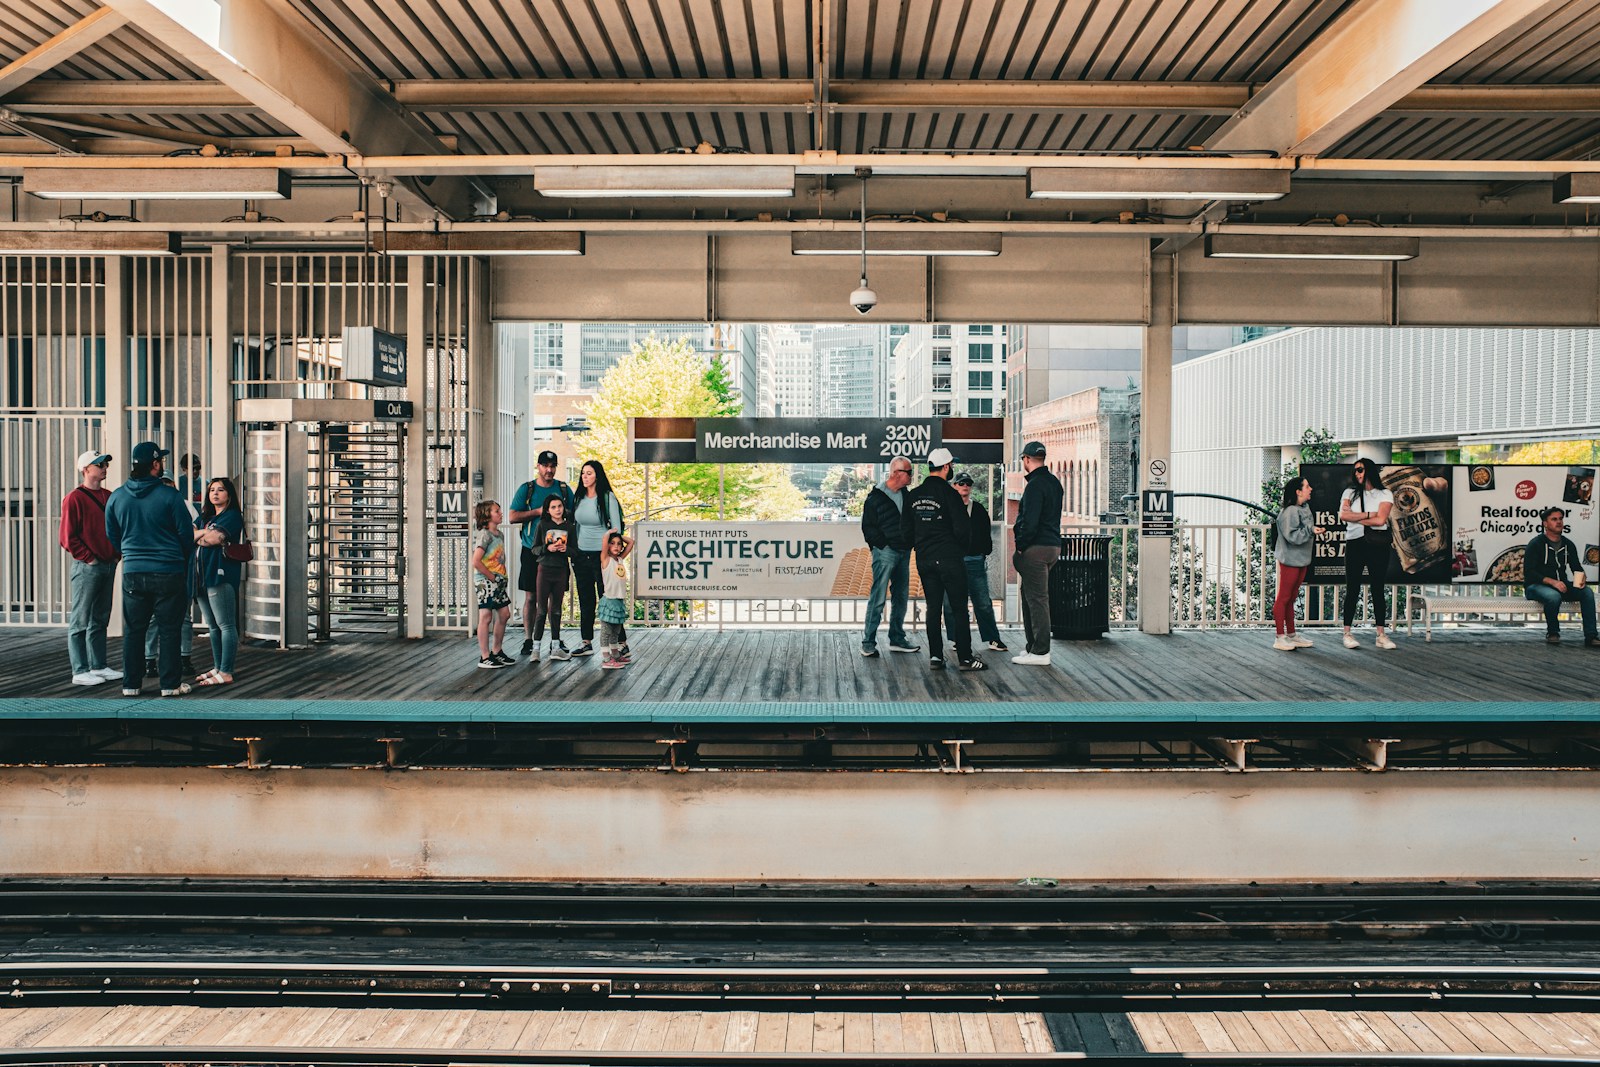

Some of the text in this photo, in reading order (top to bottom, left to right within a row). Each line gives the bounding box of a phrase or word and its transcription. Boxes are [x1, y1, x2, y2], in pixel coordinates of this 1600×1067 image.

[388, 403, 402, 415] Out
[704, 432, 868, 449] Merchandise Mart
[885, 425, 931, 441] 320N
[880, 441, 931, 456] 200W
[442, 493, 462, 512] M
[1148, 492, 1168, 511] M
[1316, 512, 1336, 526] It's
[1397, 507, 1432, 530] FLOYDS
[1482, 506, 1512, 518] Real
[1316, 530, 1346, 542] Nor
[1400, 518, 1438, 541] DELUXE
[1480, 520, 1572, 536] Chicago's ds
[646, 540, 834, 559] ARCHITECTURE
[1316, 544, 1336, 558] It's
[648, 561, 713, 579] FIRST
